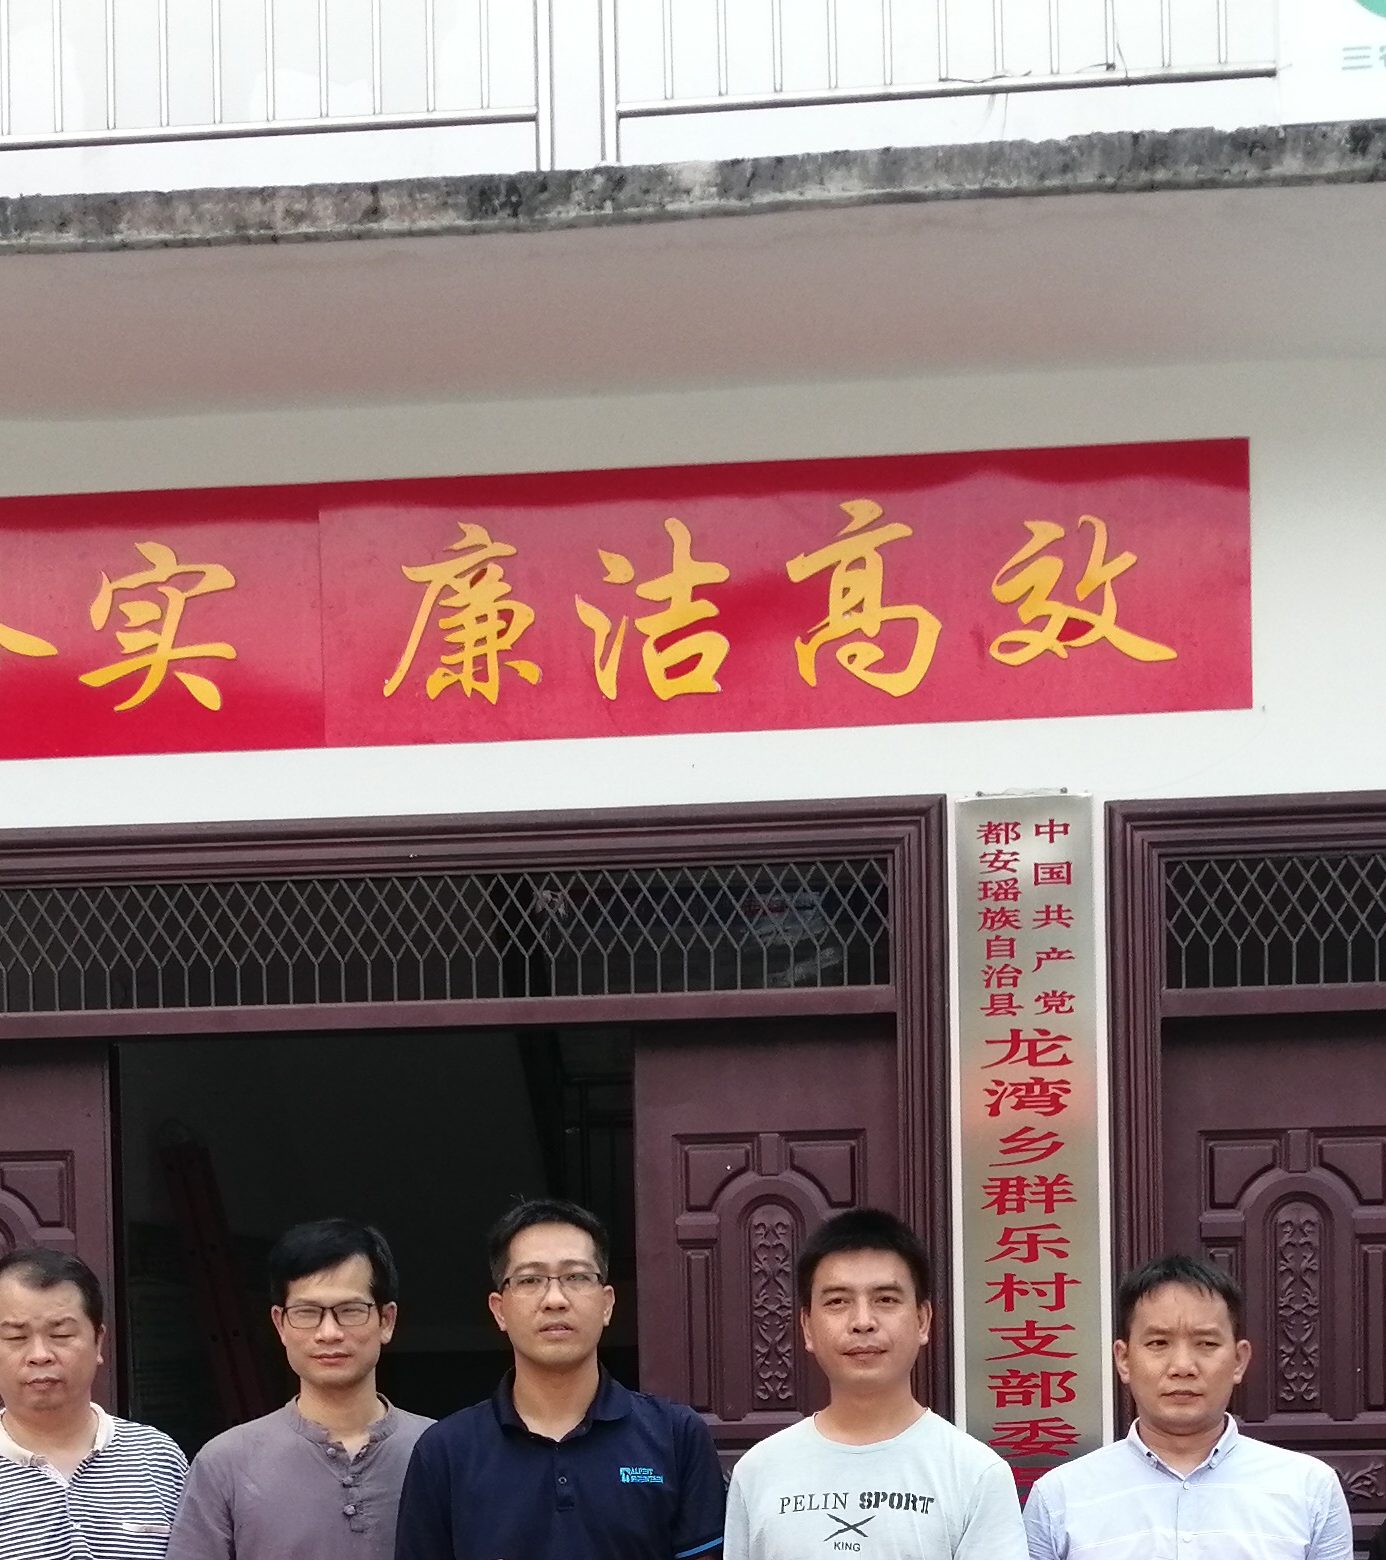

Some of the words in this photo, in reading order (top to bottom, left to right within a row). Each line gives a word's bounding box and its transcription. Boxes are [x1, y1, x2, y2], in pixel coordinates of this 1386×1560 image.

[383, 499, 1179, 705] 廉洁高效
[976, 820, 1023, 1018] 都安瑶族自治县
[1032, 818, 1076, 1016] 中国共产党
[981, 1027, 1083, 1486] 龙湾乡群乐村支部委
[779, 1492, 849, 1515] PELIN
[858, 1490, 934, 1515] SPORT
[833, 1541, 860, 1552] KING
